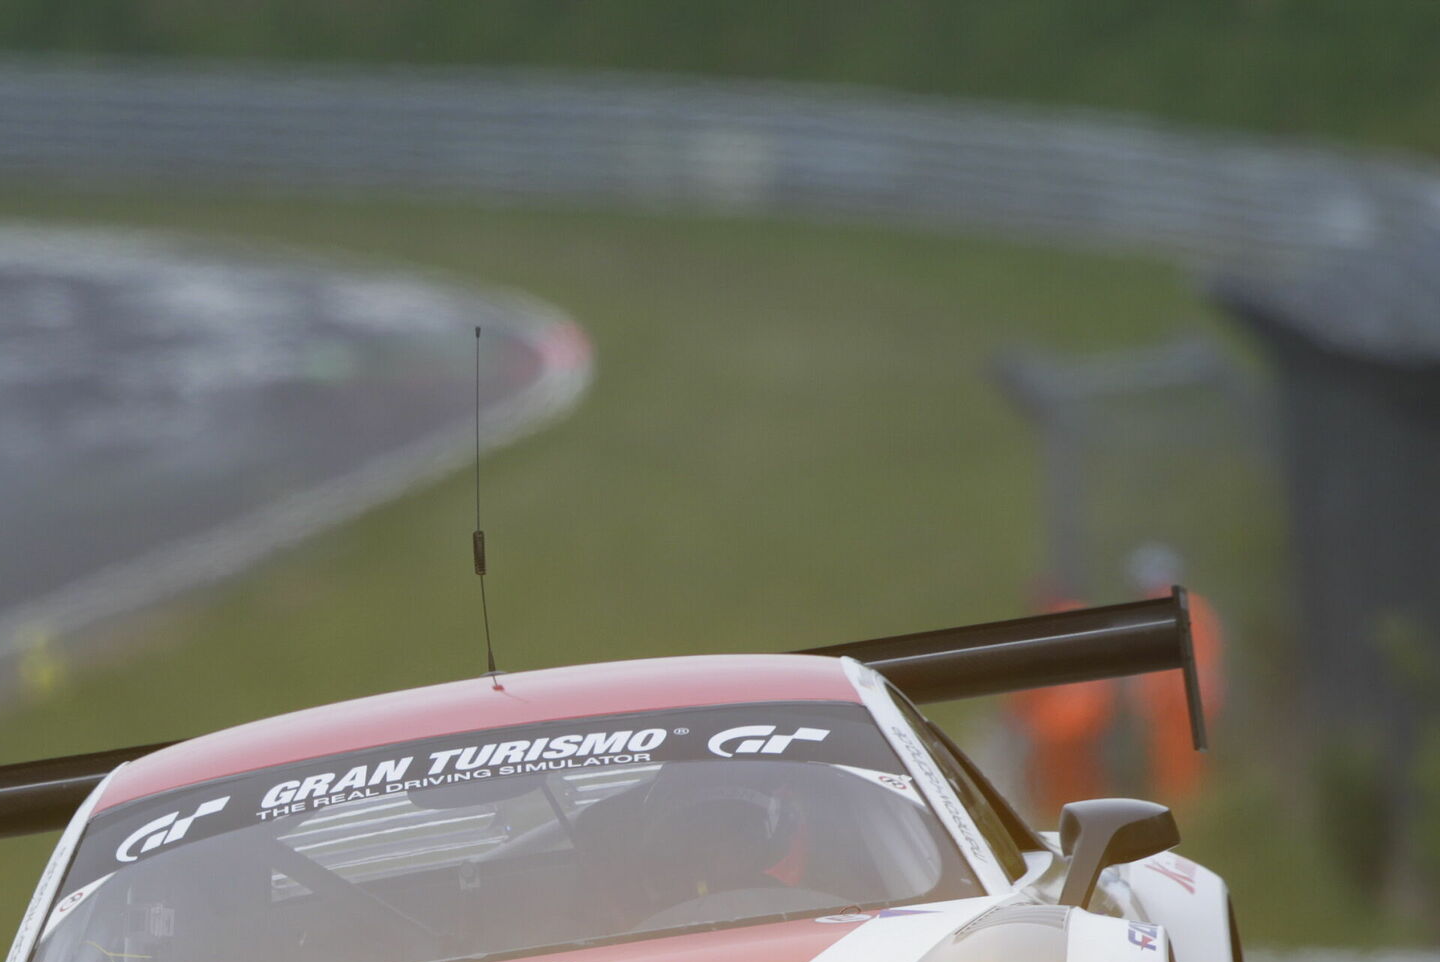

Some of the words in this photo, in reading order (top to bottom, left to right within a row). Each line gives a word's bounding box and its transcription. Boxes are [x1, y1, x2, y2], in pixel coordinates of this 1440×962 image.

[256, 802, 307, 820] THE
[313, 788, 380, 809] REAL
[386, 769, 492, 794] DRIVING
[498, 753, 651, 775] SIMULATOR
[260, 756, 413, 809] GRAN
[428, 728, 667, 775] TURISMO
